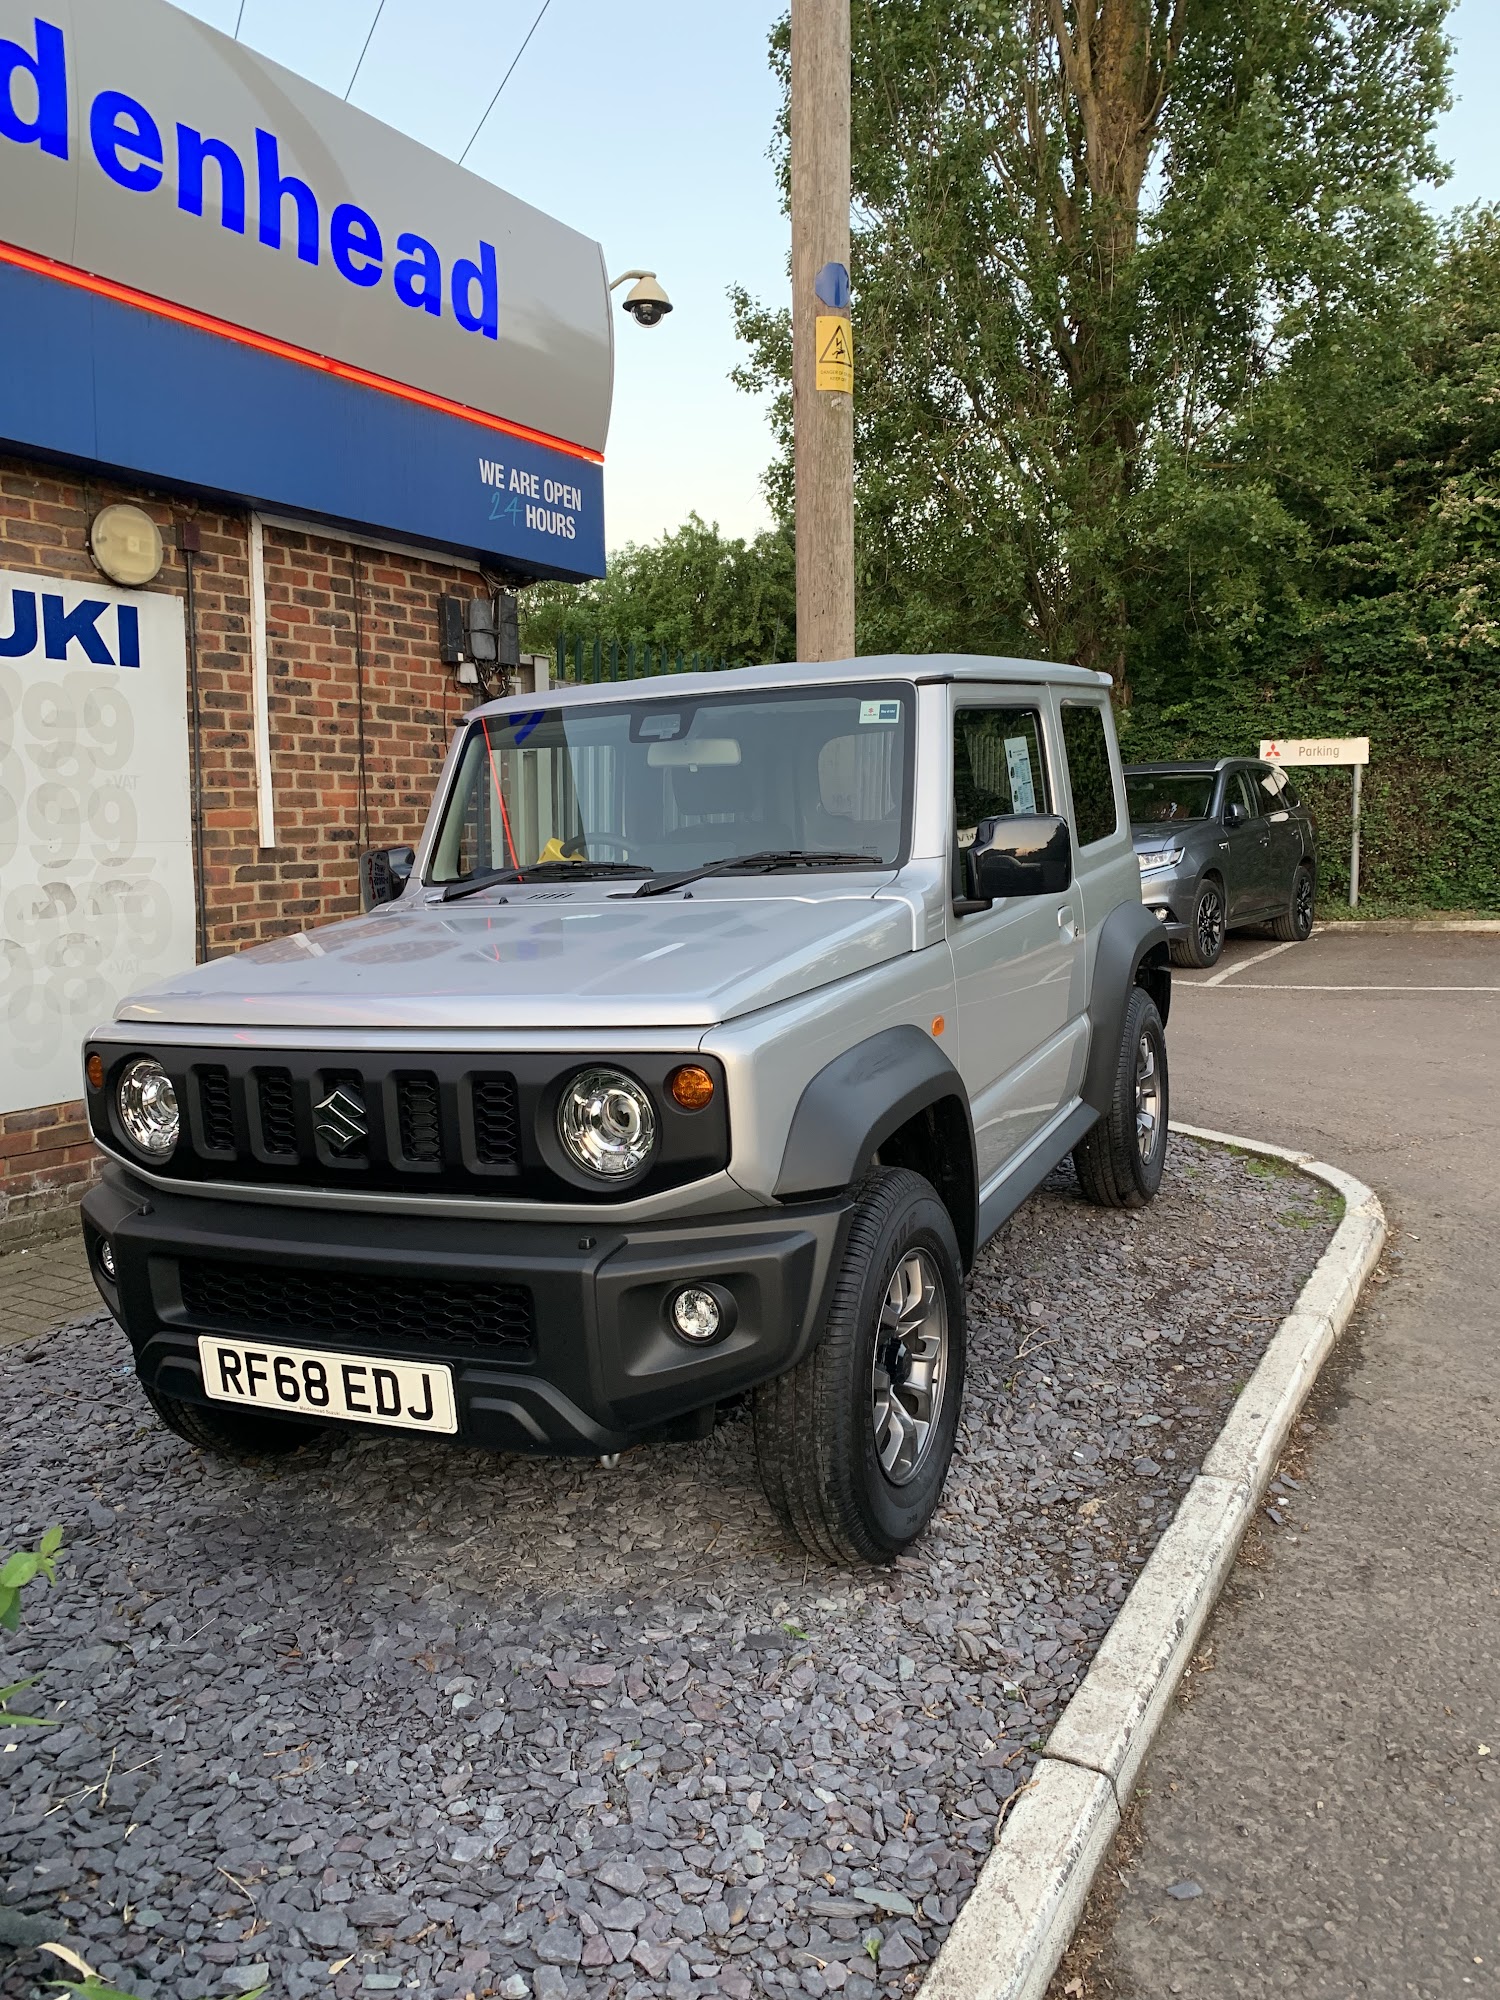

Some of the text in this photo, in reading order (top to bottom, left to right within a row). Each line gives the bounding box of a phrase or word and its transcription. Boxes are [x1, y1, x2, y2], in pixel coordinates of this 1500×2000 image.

[479, 458, 582, 511] WE ARE OPEN
[488, 491, 576, 540] 24 HOURS
[0, 589, 140, 668] UKI
[1298, 746, 1339, 758] Parking
[217, 1347, 434, 1421] RF68 EDJ
